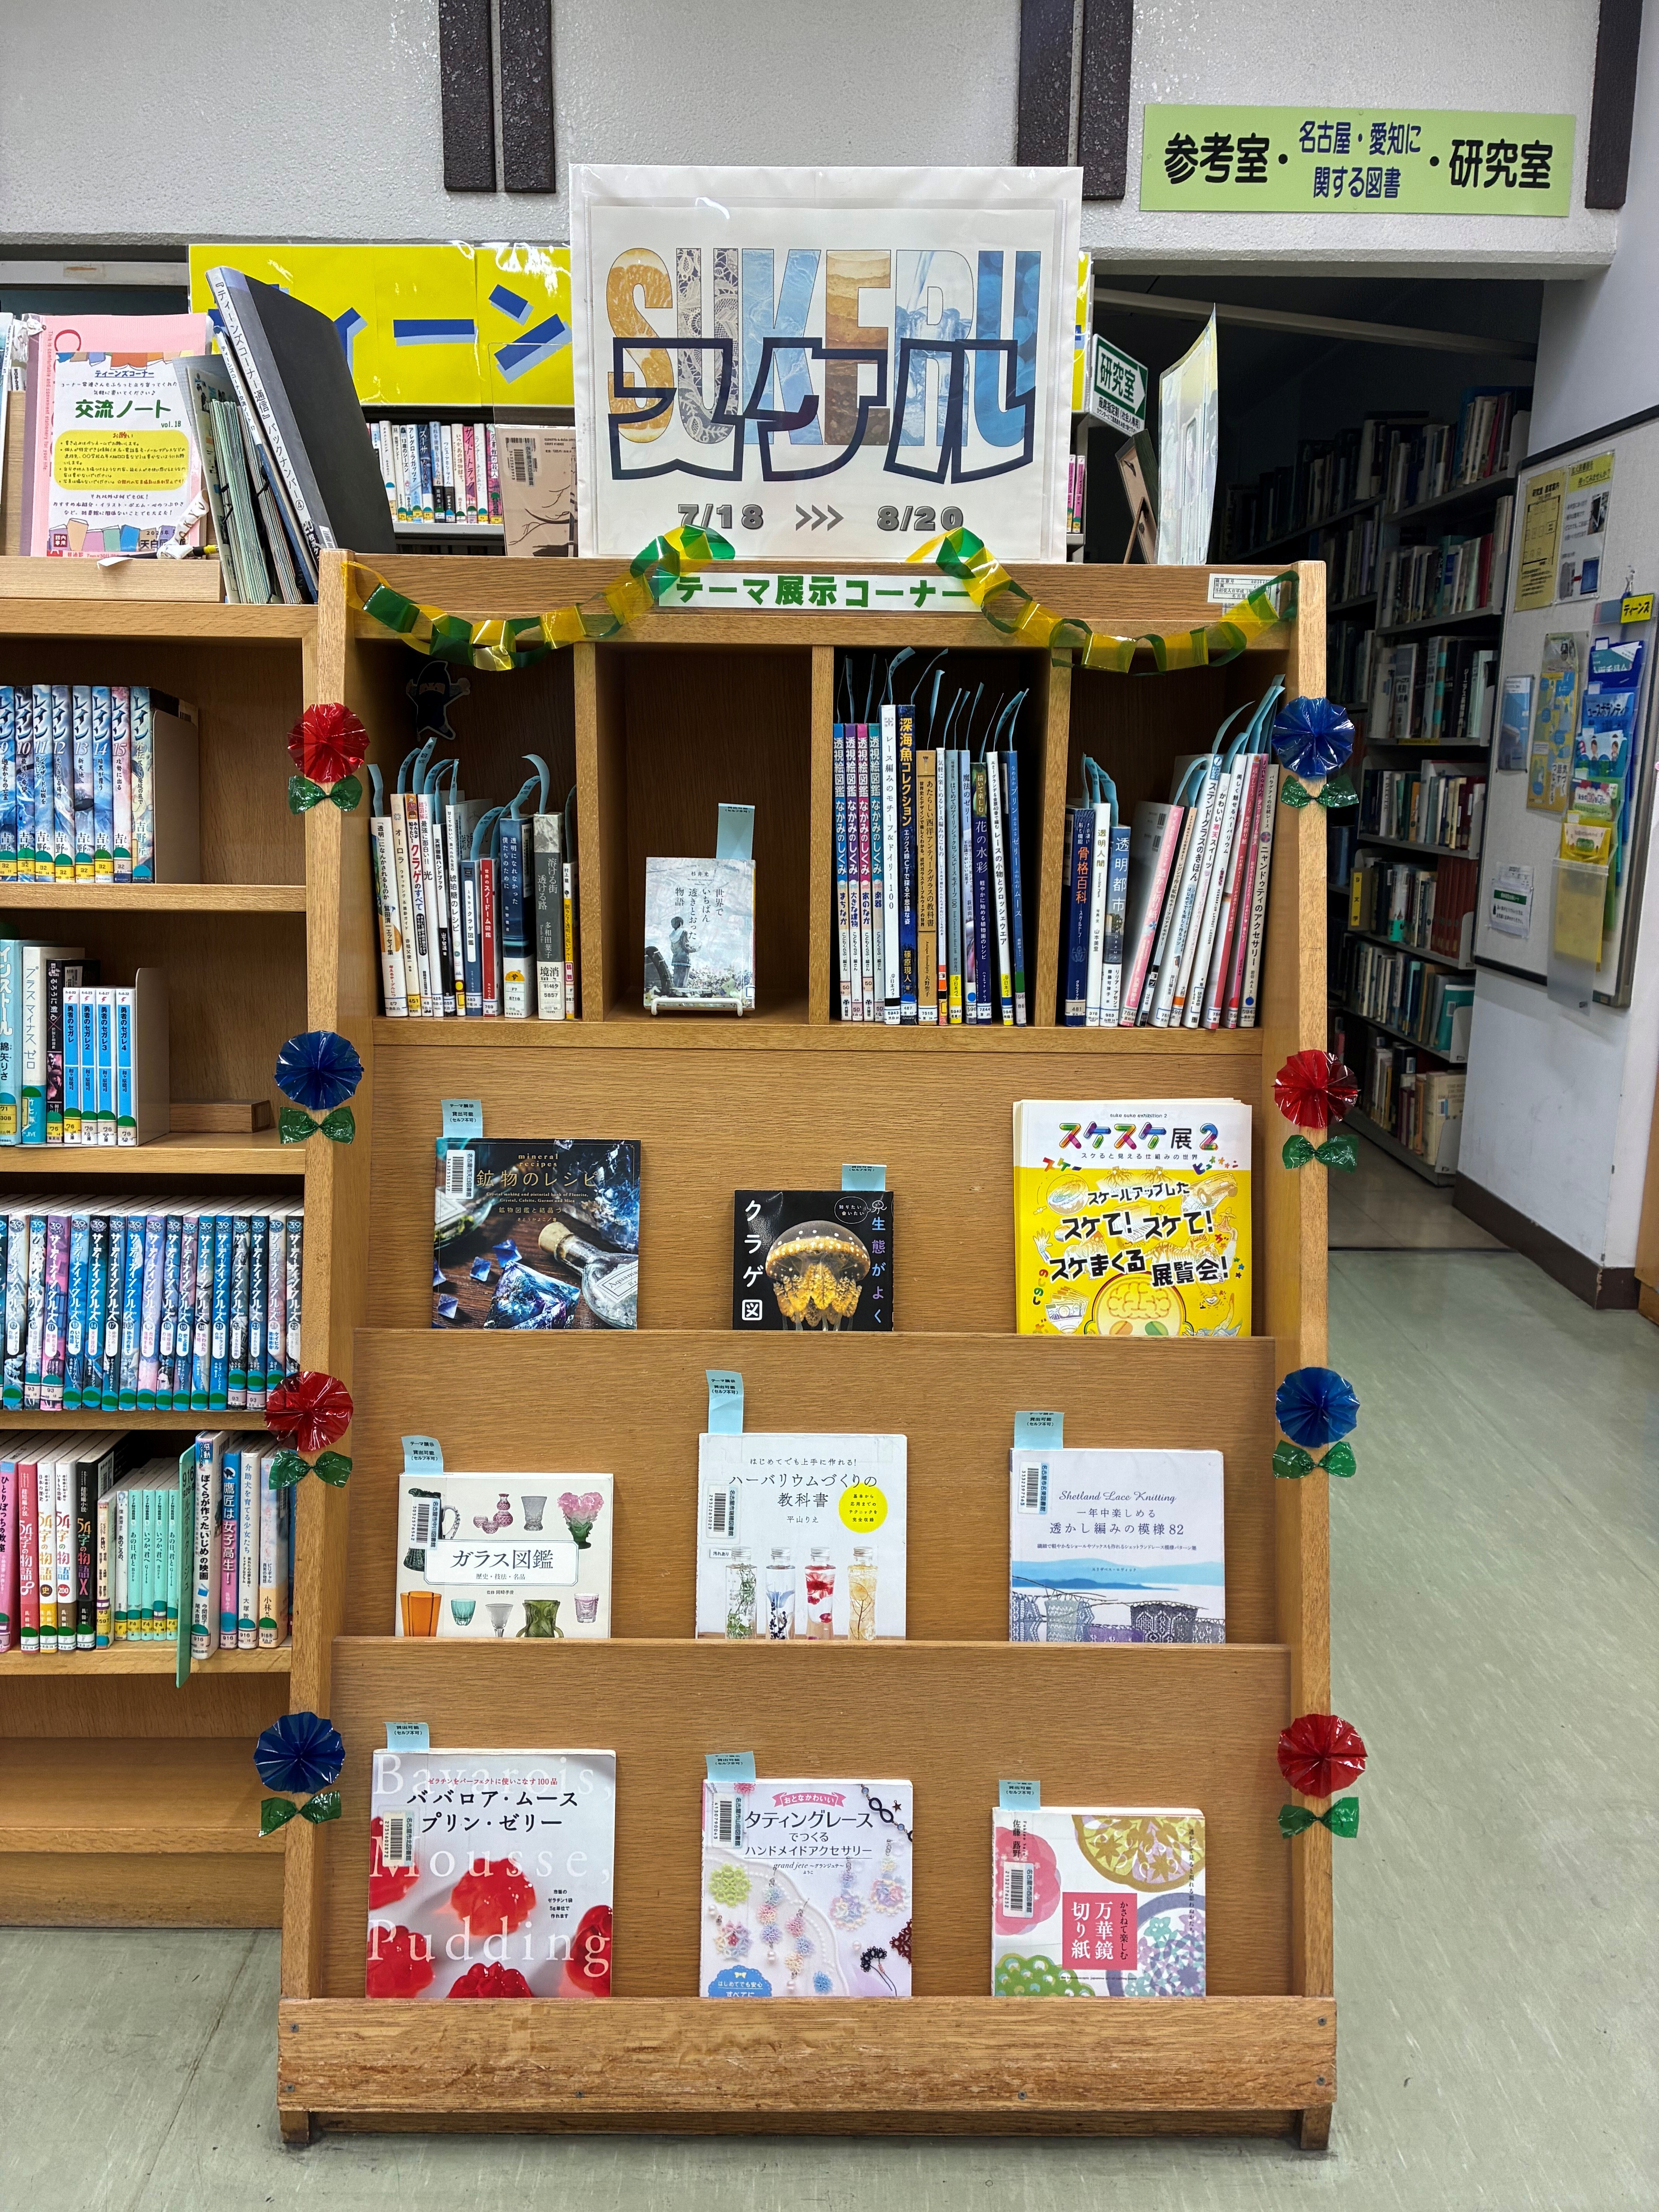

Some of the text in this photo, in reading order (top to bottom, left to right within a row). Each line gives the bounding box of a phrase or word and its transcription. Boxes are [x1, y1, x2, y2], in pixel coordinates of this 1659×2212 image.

[1299, 120, 1421, 155] 名古屋・愛知に
[1313, 166, 1401, 199] 関する図書
[606, 247, 1041, 447] SUKERU
[1101, 352, 1135, 403] 研究室
[75, 399, 171, 418] 交流ノート
[678, 504, 963, 531] 7/18 8/20
[676, 575, 972, 608] テーマ展示コーナー
[16, 694, 32, 755] レイン 10
[33, 694, 48, 754] レイン 11
[52, 694, 66, 754] レイン 12
[73, 695, 89, 740] レイン
[93, 696, 108, 756] レイン 14
[112, 696, 126, 741] レイン
[75, 742, 89, 756] 13
[113, 743, 127, 756] 15
[900, 718, 913, 827] 深海魚コレクション
[833, 737, 847, 874] 透視絵図鑑 なかみのしくみ
[845, 737, 858, 874] 透視絵図鑑 なかみのしくみ
[395, 829, 404, 864] オーロラ
[975, 820, 988, 874] 花の水彩
[1096, 828, 1107, 867] 透明人間
[1190, 782, 1216, 881] ステンドグラスのきほん
[377, 822, 390, 900] 「透明」になんかされるものか
[926, 780, 934, 927] あたらしい西洋アンティークガラスの教科書
[411, 844, 423, 910] クラゲのすべて
[424, 871, 433, 881] 光
[510, 838, 519, 905] 透明になれなかった
[547, 858, 558, 894] 溶ける街
[1076, 846, 1089, 904] 骨格百科
[1112, 836, 1130, 912] 透明都市
[449, 875, 460, 932] 琥珀糖のレシピ
[538, 875, 548, 910] 透ける路
[674, 888, 685, 907] 物語
[702, 888, 711, 923] いちばん
[715, 888, 725, 916] 世界で
[862, 892, 871, 925] 家のなか
[874, 891, 882, 908] 楽器
[1251, 847, 1269, 967] ニャンドゥティのアクセサリー
[688, 888, 697, 940] 透きとおった
[544, 922, 553, 958] 多和田葉子
[1059, 1121, 1220, 1151] スケスケ展2
[476, 1170, 598, 1187] 鉱物のレシピ
[1087, 1181, 1190, 1206] スケールアップした
[1062, 1210, 1213, 1240] スケて! スケて!
[742, 1200, 764, 1321] クラゲ図
[872, 1216, 886, 1323] 生態がよく
[1049, 1249, 1230, 1287] スケまくる 展覧会!
[750, 1458, 857, 1467] はじめてでも上手に作れる!
[729, 1473, 878, 1489] ハーバリウムづくりの
[1059, 1490, 1177, 1503] Shetland Lace Knitting
[244, 1463, 252, 1554] 介助犬を育てる少女たち
[777, 1492, 829, 1509] 教科書
[1077, 1508, 1156, 1518] 一年中楽しめる
[199, 1474, 212, 1580] ぼくらが作った「いじめ」の映画
[222, 1482, 235, 1584] 鷹匠は女子高生!
[787, 1515, 819, 1524] 平山りえ
[449, 1549, 554, 1570] ガラス図鑑
[406, 1789, 579, 1808] ババロア・ムース
[428, 1777, 558, 1786] ゼラチンをパーフェクトに使いこなす100品
[784, 1794, 835, 1804] おとなかわいい
[422, 1813, 563, 1834] プリン・ゼリー
[744, 1810, 874, 1829] タティングレース
[788, 1831, 829, 1843] でつくる
[745, 1846, 872, 1857] ハンドメイドアクセサリー
[773, 1862, 792, 1871] grand
[367, 1914, 610, 1978] Pudding
[1071, 1901, 1091, 1960] 切り紙
[1095, 1901, 1113, 1960] 万華鏡
[1119, 1901, 1129, 1960] かさねて楽しむ
[717, 1980, 763, 1989] はじめてでも安心
